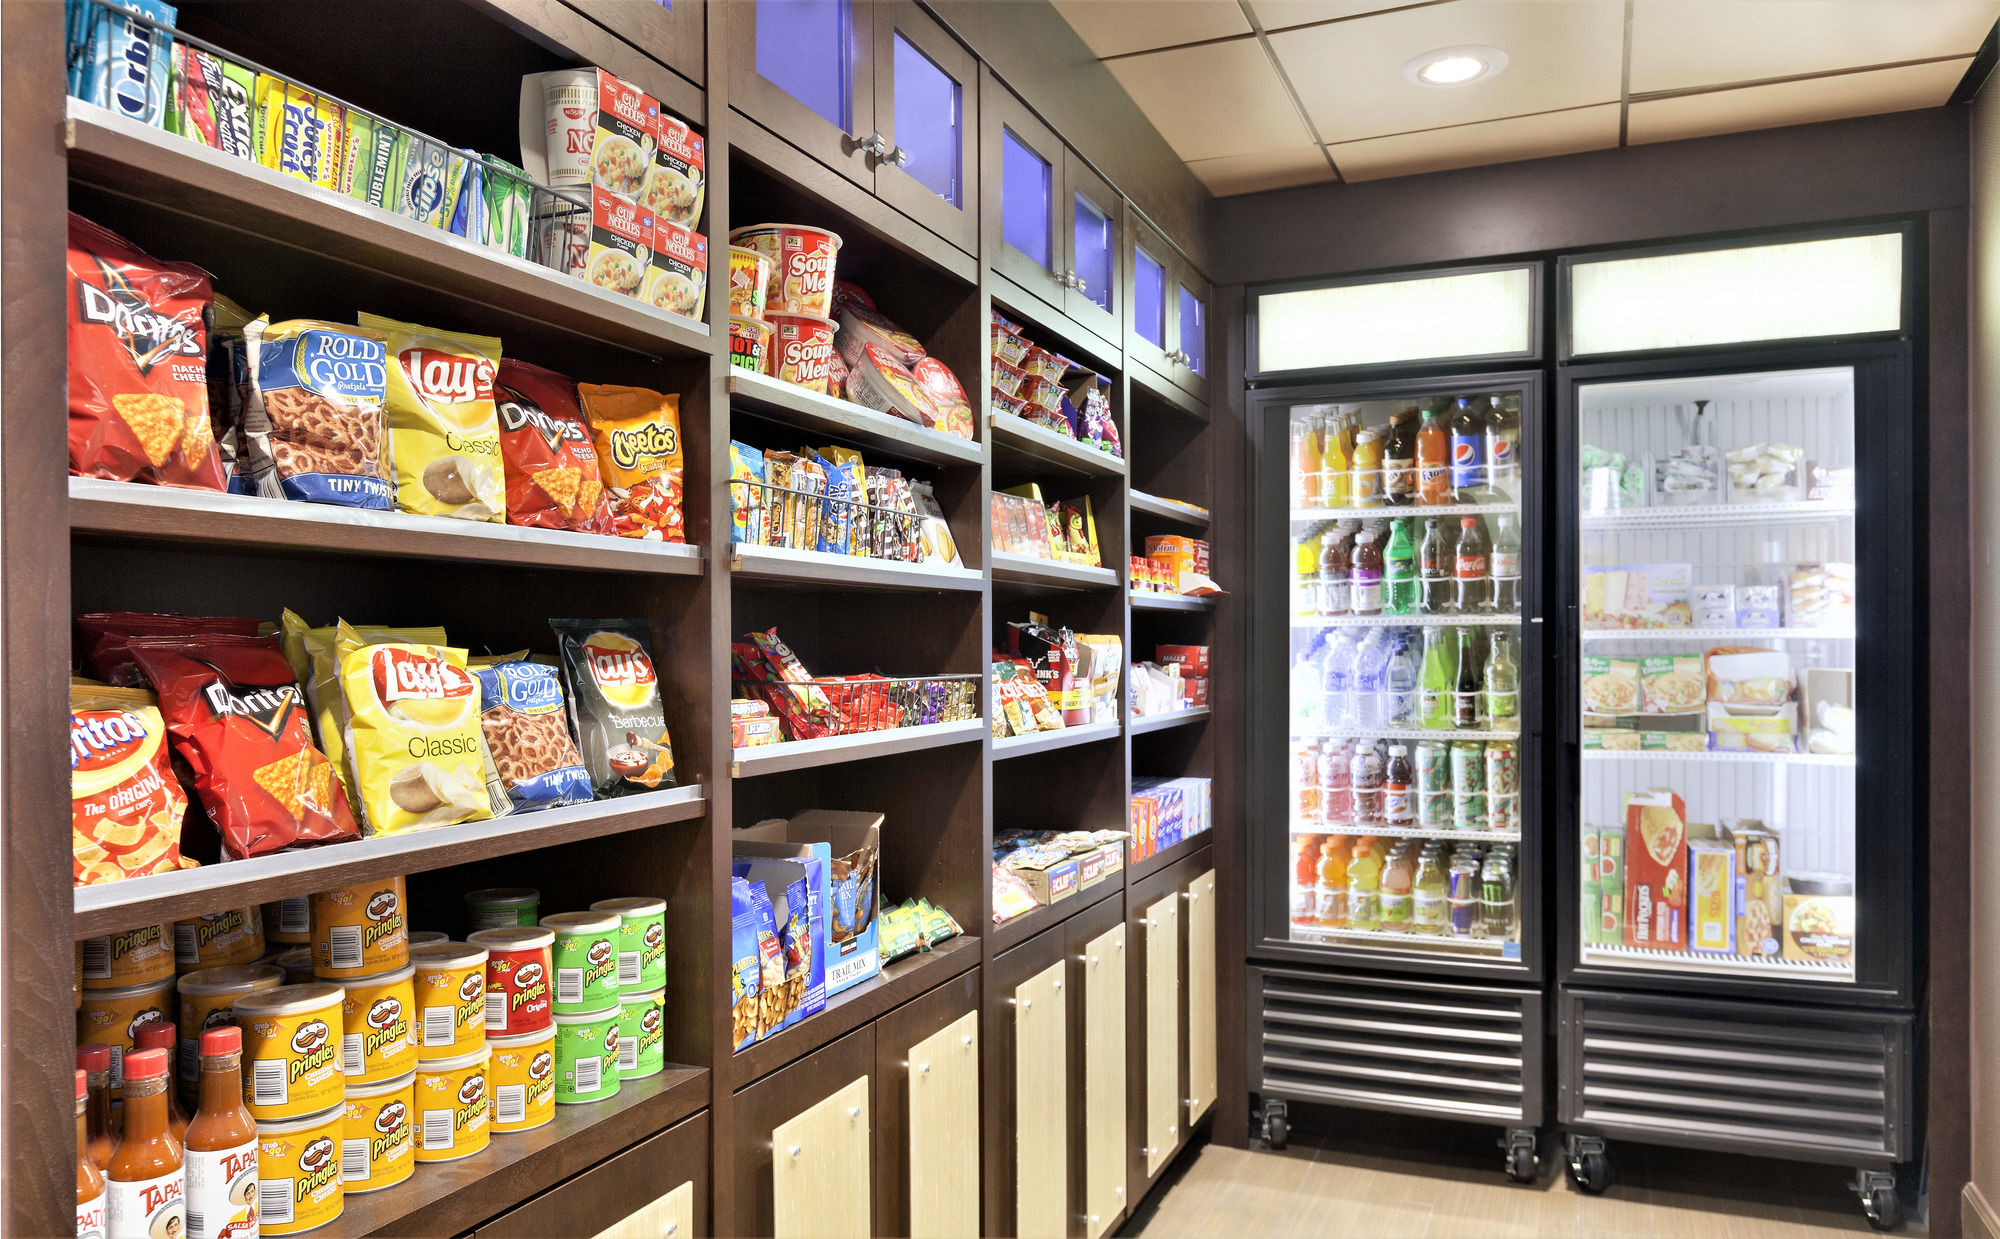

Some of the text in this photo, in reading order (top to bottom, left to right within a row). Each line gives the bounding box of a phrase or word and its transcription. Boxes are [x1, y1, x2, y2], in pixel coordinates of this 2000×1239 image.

[613, 100, 648, 128] NOODLES
[622, 91, 641, 110] CUP
[282, 103, 303, 174] Fruit
[616, 120, 641, 139] CHICKEN
[667, 127, 686, 146] CUP
[301, 106, 325, 182] Juicy
[660, 134, 693, 160] NOODLES
[346, 135, 360, 194] WRIGLEY'S
[369, 130, 394, 209] OUBLEMINT
[662, 153, 688, 170] CHICKEN
[608, 212, 641, 237] NOODLES
[616, 205, 636, 222] CUP
[610, 234, 636, 249] CHICKEN
[665, 239, 695, 262] NOODLES
[672, 232, 690, 248] CUP
[668, 258, 691, 273] CHICKEN
[317, 335, 379, 361] ROLD
[752, 344, 761, 356] &
[171, 363, 206, 375] NACH
[309, 357, 387, 389] GOLD
[408, 350, 497, 404] Lay's
[336, 380, 367, 392] Pretzels
[445, 431, 500, 458] Classic
[610, 422, 678, 470] Cheetos
[328, 477, 361, 493] TINY
[587, 646, 650, 689] Lay's
[1162, 655, 1187, 663] HALLS
[383, 648, 465, 702] Lay's
[510, 676, 557, 703] GOLD
[611, 714, 665, 729] Barbecue
[72, 711, 148, 768] ritos
[407, 732, 478, 758] Classic
[84, 774, 165, 816] The ORIGINA
[117, 797, 154, 817] CORN CHIPS
[1056, 874, 1071, 894] CLIF
[1086, 863, 1101, 881] CLIF
[114, 924, 161, 960] Pringles
[199, 910, 243, 947] Pringles
[364, 913, 402, 949] Pringles
[643, 941, 665, 969] Pringle
[585, 957, 616, 989] Pringles
[831, 956, 867, 982] TRAIL MIX
[512, 982, 547, 1013] Pringles
[366, 1020, 407, 1057] Pringles
[289, 1043, 335, 1085] Pringles
[456, 1095, 488, 1131] Pringles
[372, 1122, 410, 1162] Pringles
[296, 1159, 339, 1203] Pringles
